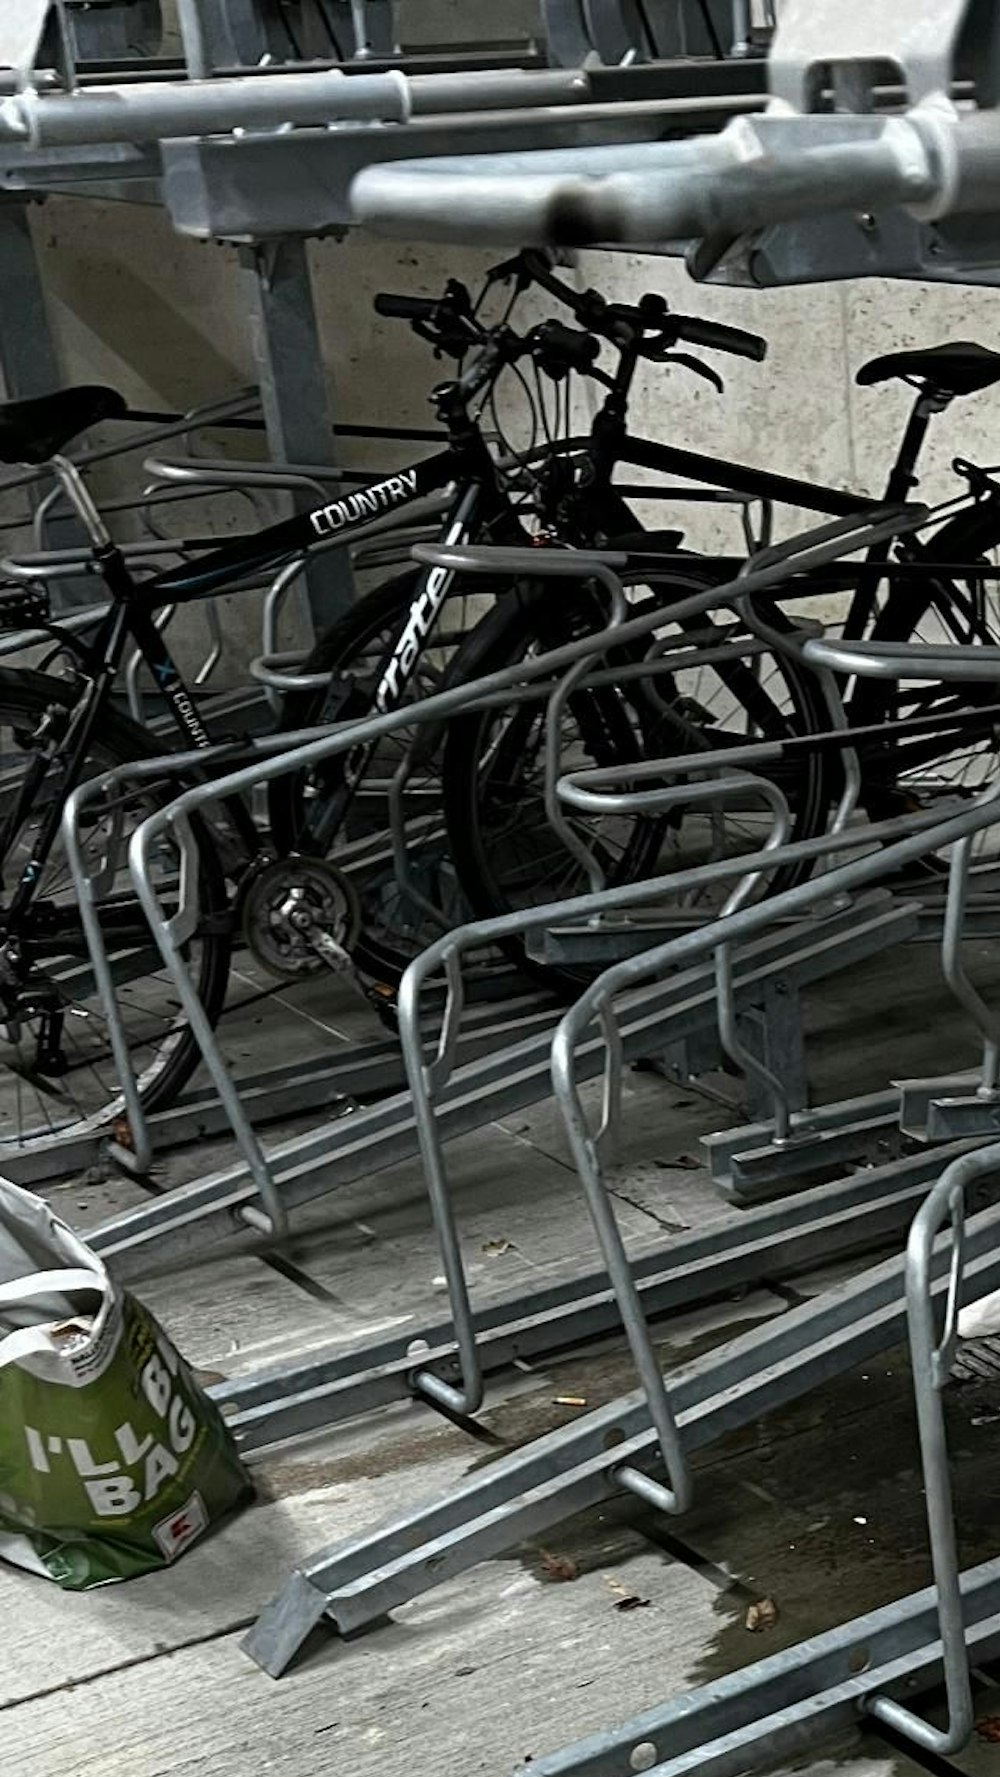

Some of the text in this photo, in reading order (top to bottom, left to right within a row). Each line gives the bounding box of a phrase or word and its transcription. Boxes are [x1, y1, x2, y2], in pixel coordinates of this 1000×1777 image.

[309, 469, 417, 536] COUNTRY
[172, 691, 212, 748] COUNT
[25, 1421, 154, 1477] I'LL
[84, 1394, 196, 1517] BAG
